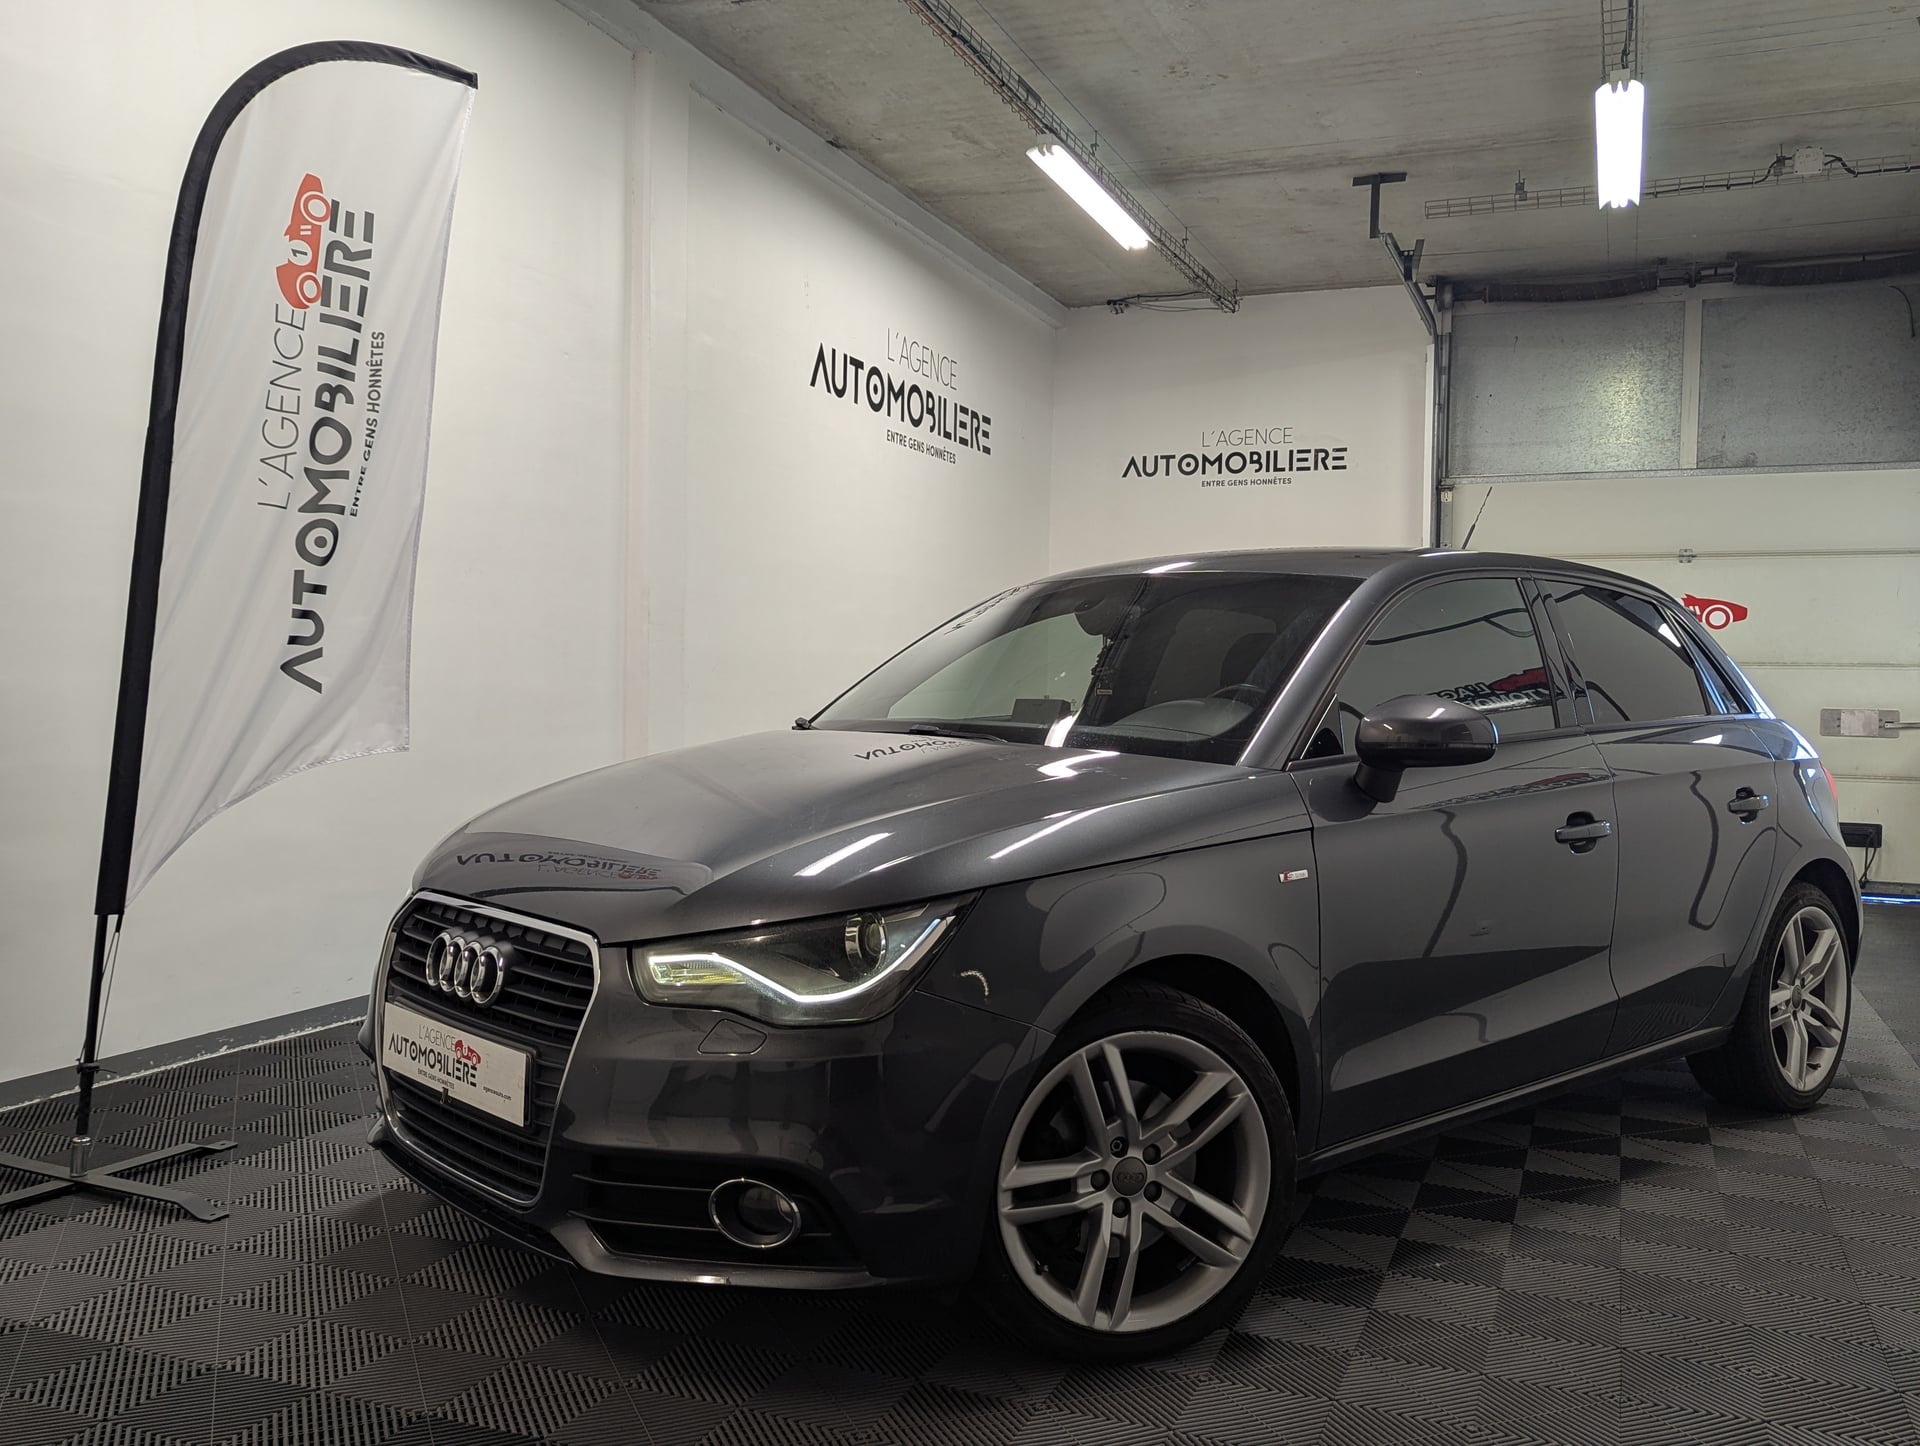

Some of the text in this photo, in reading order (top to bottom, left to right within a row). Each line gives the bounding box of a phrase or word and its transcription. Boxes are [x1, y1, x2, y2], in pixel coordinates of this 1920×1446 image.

[887, 327, 958, 391] L'AGENCE
[257, 303, 307, 510] L'AGENCE
[350, 331, 385, 517] ENTRE GENS HONNÊTES
[809, 342, 992, 456] AUTOMOBILIERE
[280, 198, 375, 694] AUTOMOBILIERE
[886, 429, 957, 465] ENTRE GENS HONNÊTES
[1121, 447, 1348, 479] AUTOMOBILIERE
[1201, 427, 1294, 448] L'AGENCE
[1201, 476, 1293, 488] ENTRE GENS HONNÊTES
[388, 1031, 478, 1088] AUTOMOBILIERE
[418, 1023, 456, 1052] L'AGENCE
